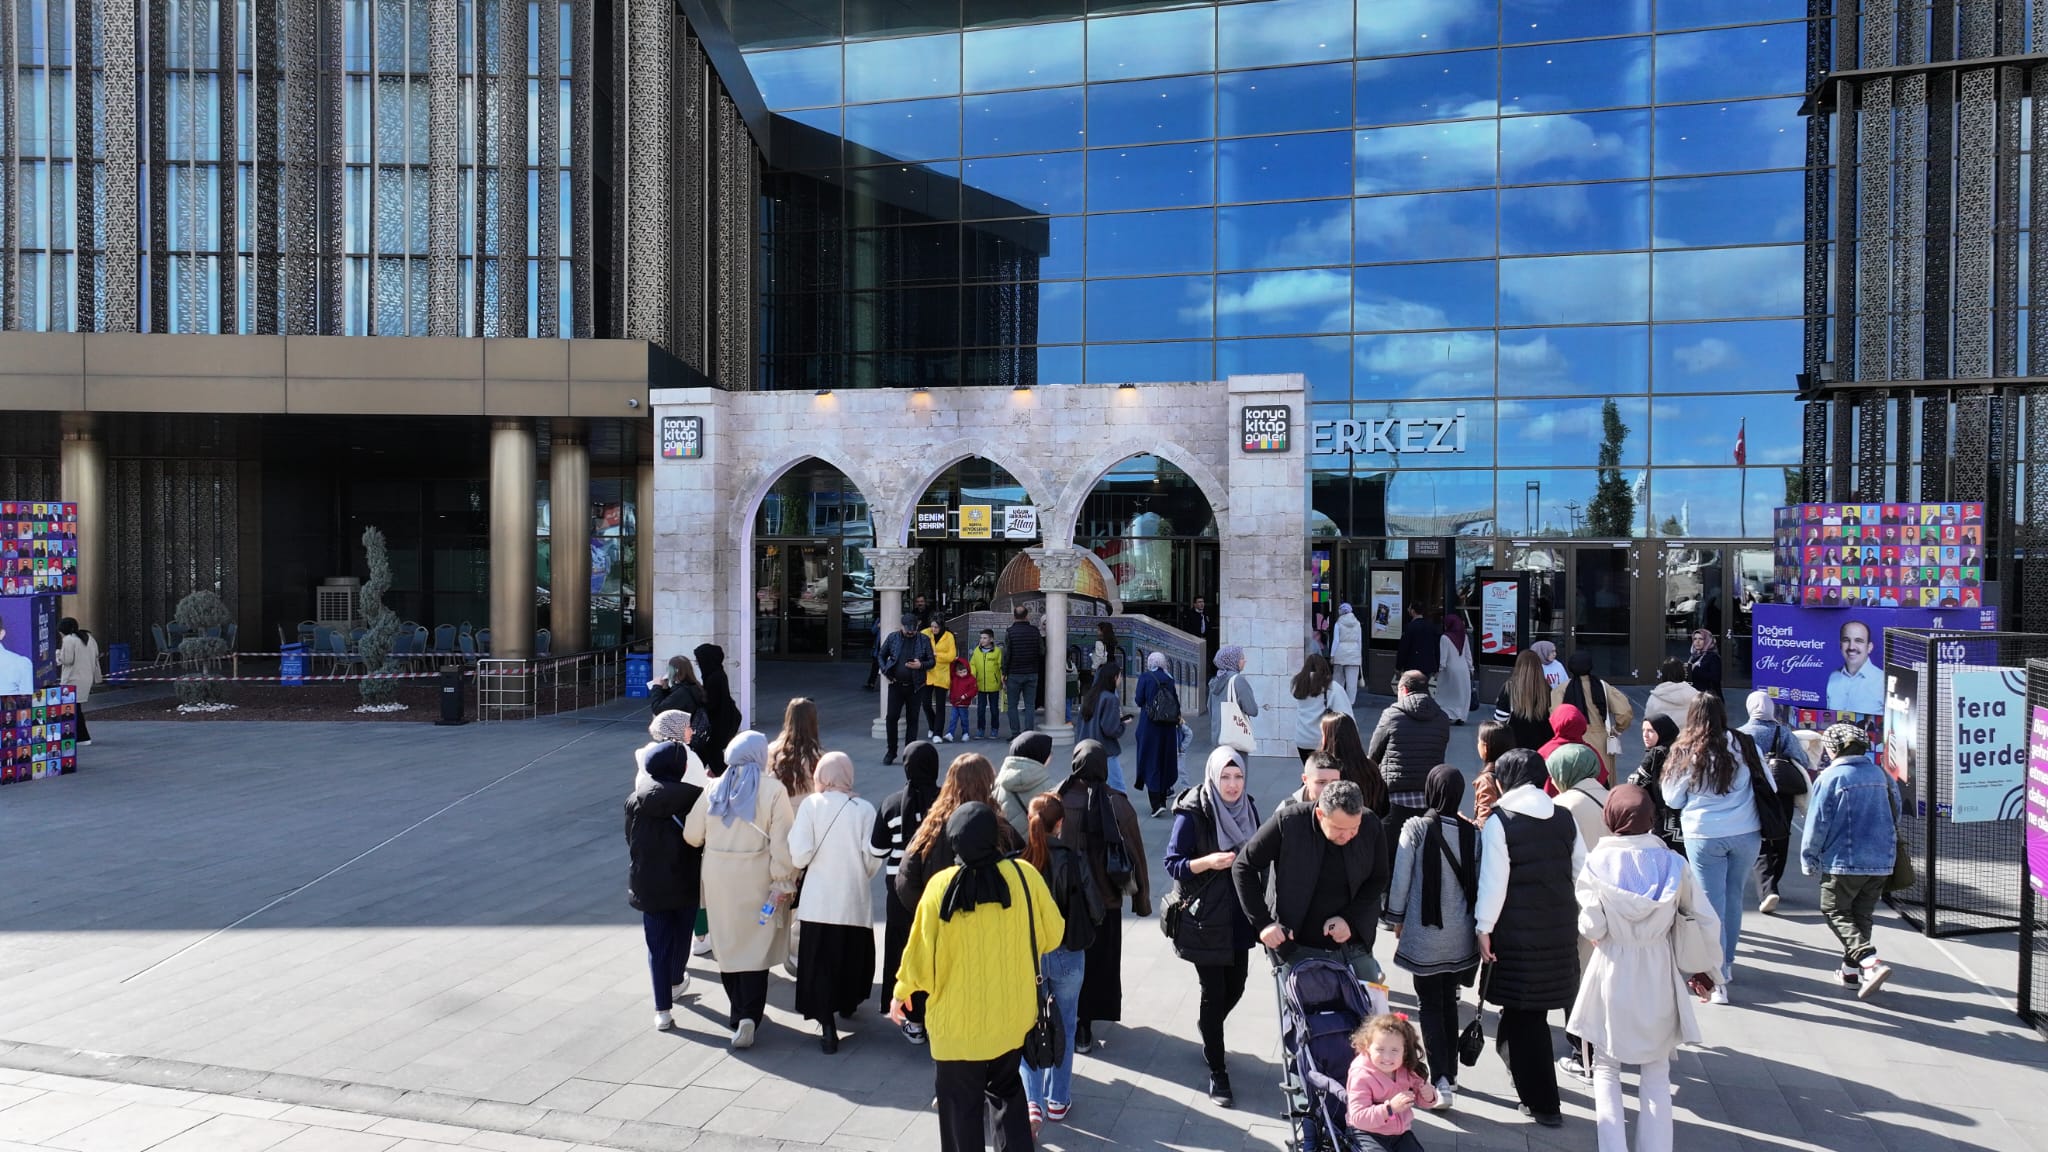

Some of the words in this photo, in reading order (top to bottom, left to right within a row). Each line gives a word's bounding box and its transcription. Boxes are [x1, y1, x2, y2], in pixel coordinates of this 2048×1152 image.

[1245, 408, 1286, 421] konya
[664, 419, 697, 430] konya
[1245, 419, 1286, 434] kitap
[1311, 407, 1466, 454] ERKEZİ
[664, 428, 697, 441] kitap
[1245, 431, 1286, 447] günleri
[918, 513, 945, 522] BENİM
[918, 522, 945, 531] ŞEHRİM
[1757, 624, 1793, 638] Değerli
[1757, 635, 1826, 650] Kitapseverler
[1937, 641, 1966, 662] itap
[1957, 696, 2006, 719] fera
[1958, 723, 1996, 745] her
[1958, 743, 2025, 774] yerde
